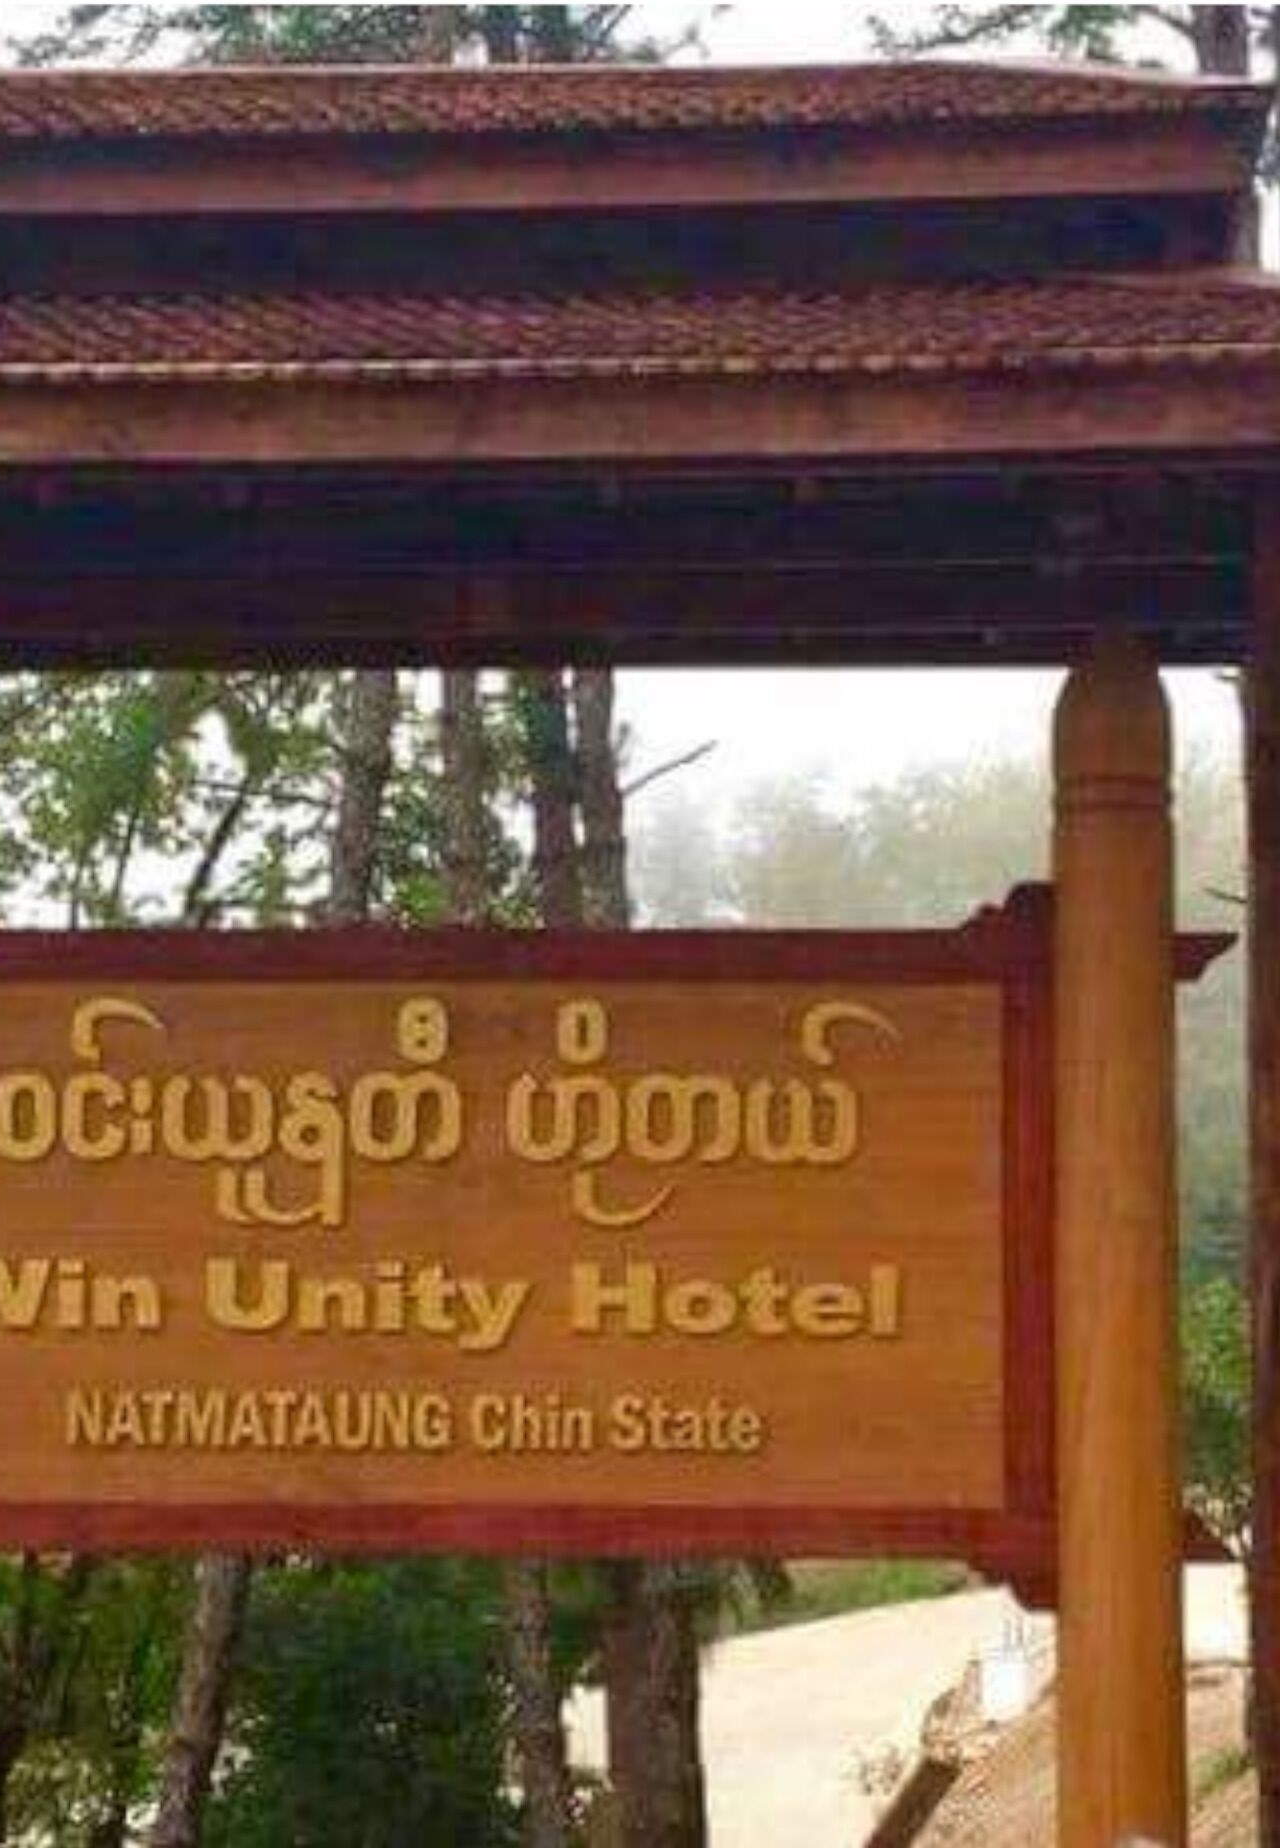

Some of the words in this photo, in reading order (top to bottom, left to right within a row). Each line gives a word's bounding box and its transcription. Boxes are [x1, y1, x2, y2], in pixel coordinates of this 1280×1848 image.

[505, 998, 902, 1227] ဟိုတယ်
[205, 1257, 531, 1351] Unity
[570, 1260, 900, 1336] Hotel
[65, 1387, 452, 1450] NATMATAUNG
[471, 1391, 594, 1450] Chin
[609, 1391, 762, 1452] State
